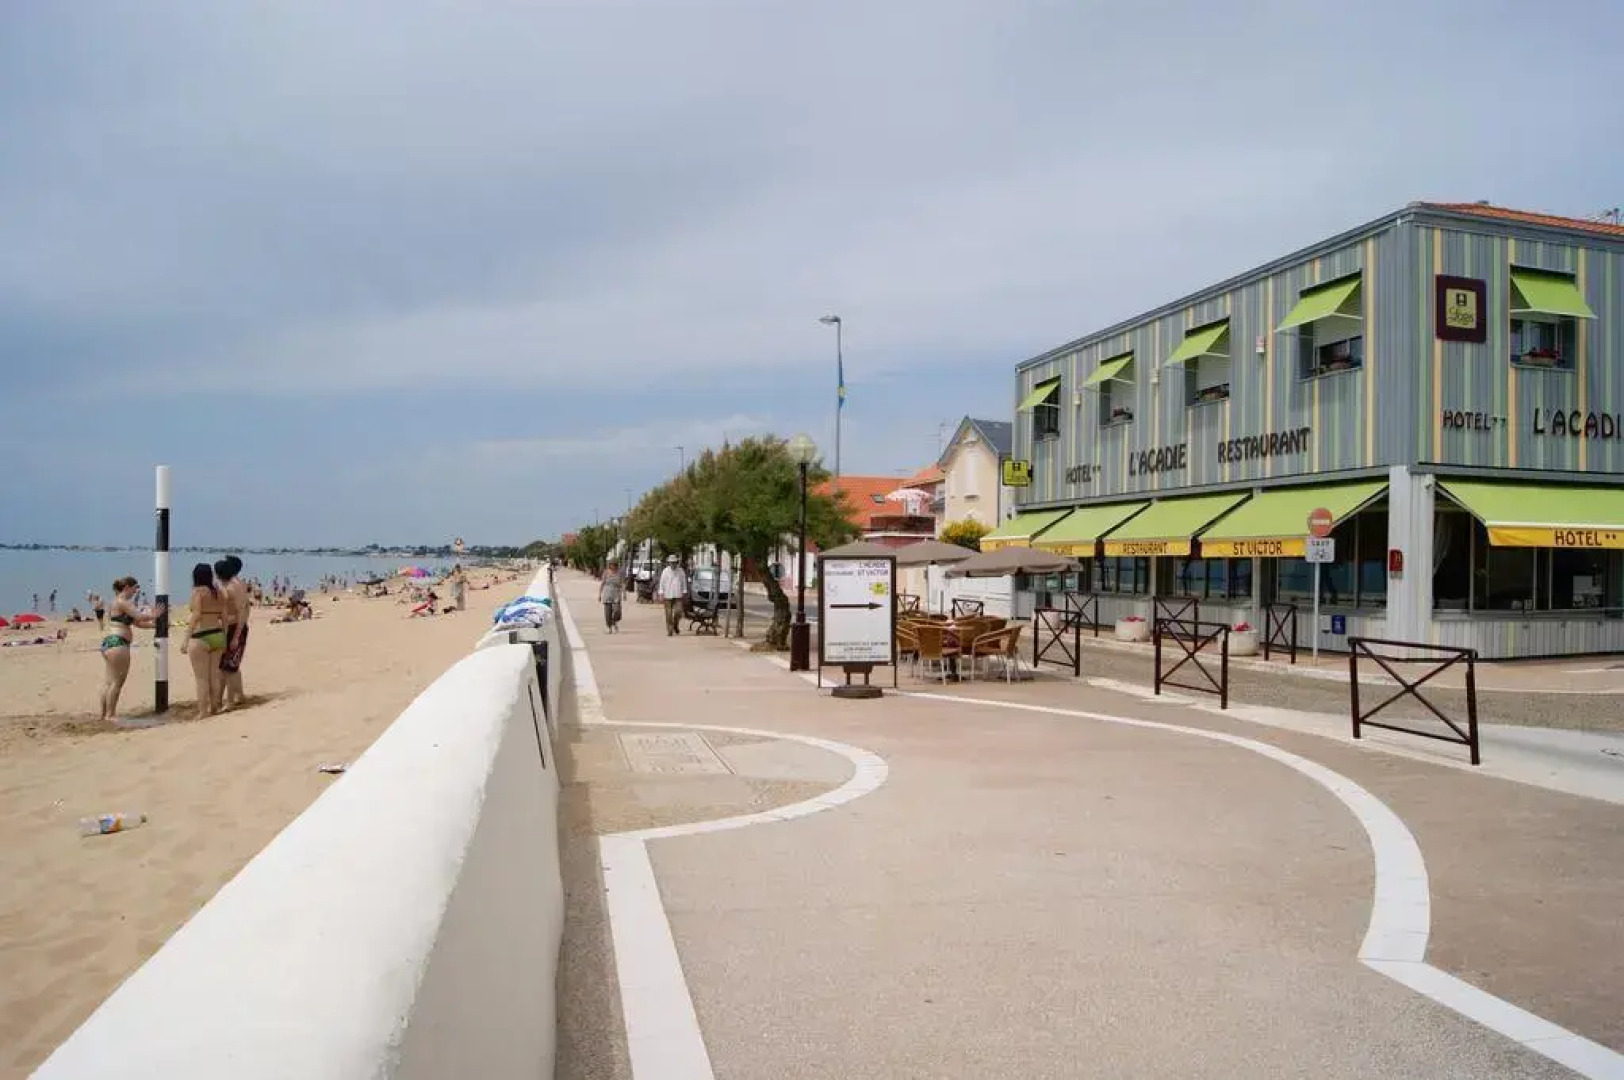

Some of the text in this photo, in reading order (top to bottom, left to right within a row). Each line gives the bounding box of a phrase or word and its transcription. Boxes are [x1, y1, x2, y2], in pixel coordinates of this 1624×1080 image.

[1129, 444, 1186, 476] L'ACADIE
[1218, 427, 1310, 463] RESTAURANT
[1554, 530, 1602, 546] HOTEL
[1123, 542, 1167, 554] RESTAURANT
[1233, 541, 1282, 555] ST VICTOR
